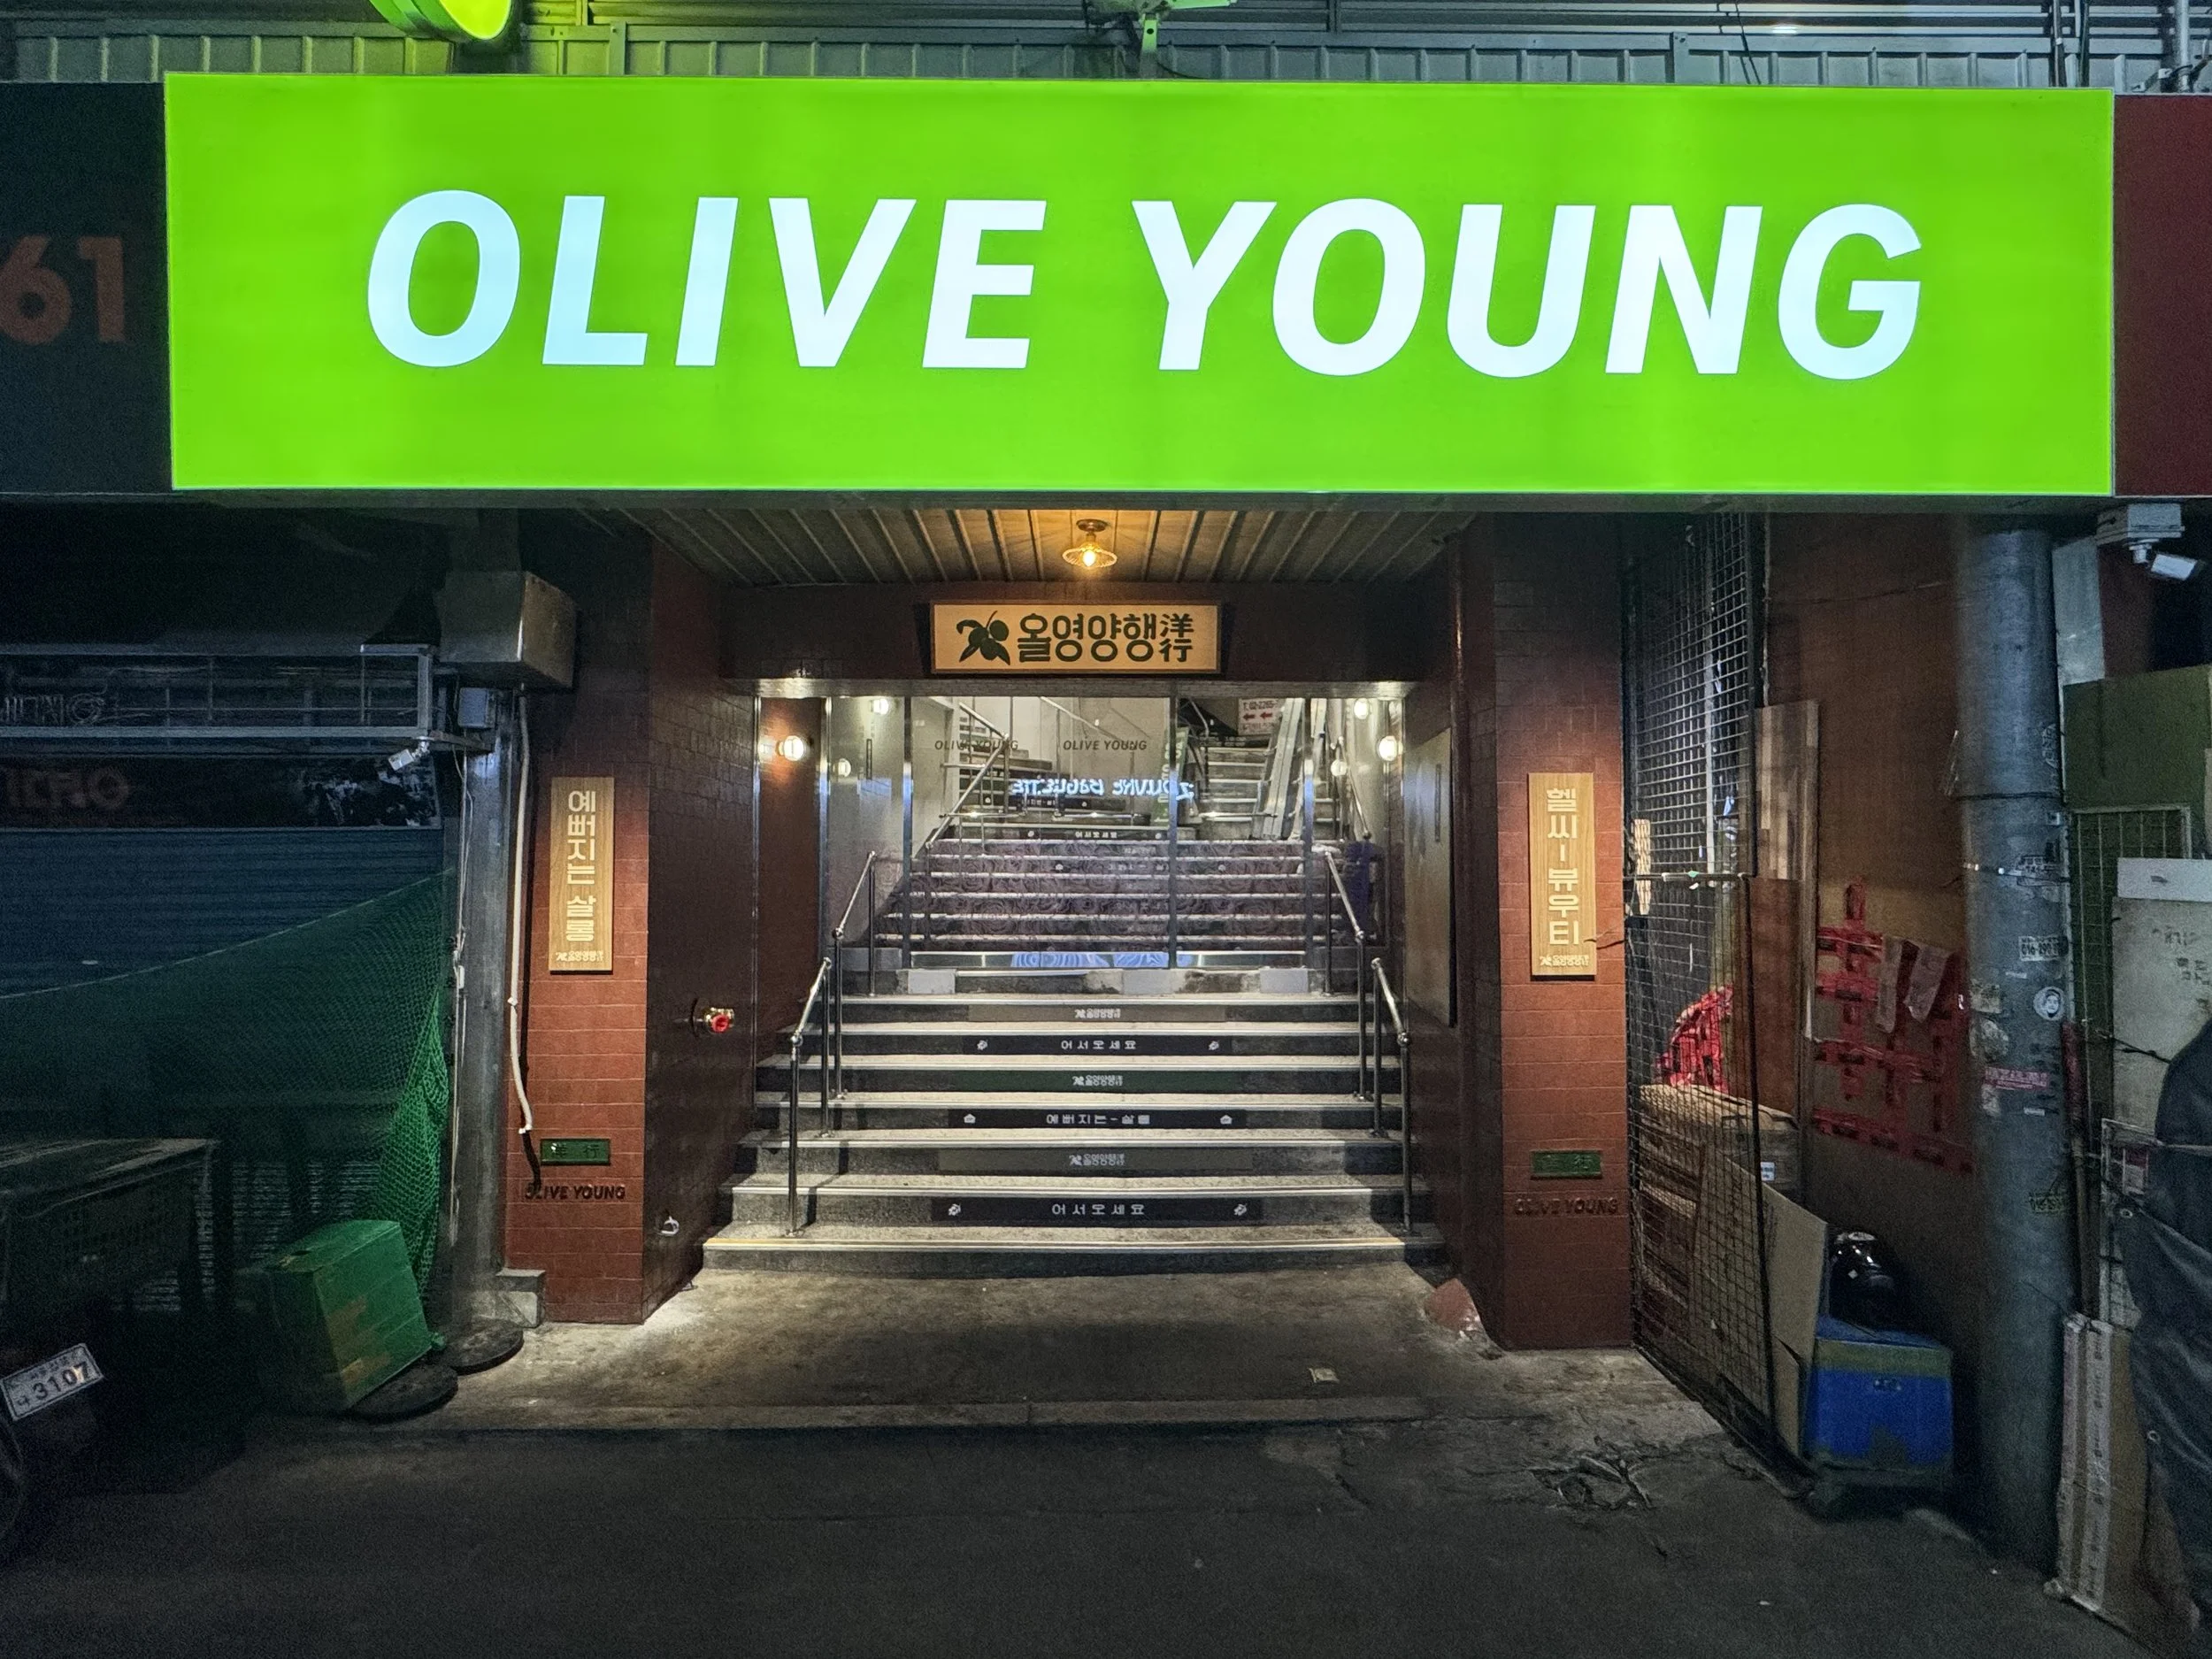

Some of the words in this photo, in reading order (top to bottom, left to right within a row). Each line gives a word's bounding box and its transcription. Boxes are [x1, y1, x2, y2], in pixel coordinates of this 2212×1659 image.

[366, 190, 1048, 368] OLIVE
[1134, 200, 1922, 380] YOUNG
[1063, 740, 1099, 751] OLIVE
[1104, 740, 1147, 751] YOUNG
[566, 789, 596, 885] 예뻐지는
[565, 895, 597, 942] 살롱
[1060, 1040, 1136, 1050] 어서오세요
[573, 1185, 626, 1200] YOUNG
[1051, 1203, 1145, 1216] 어서오세요
[32, 1361, 89, 1401] 3107
